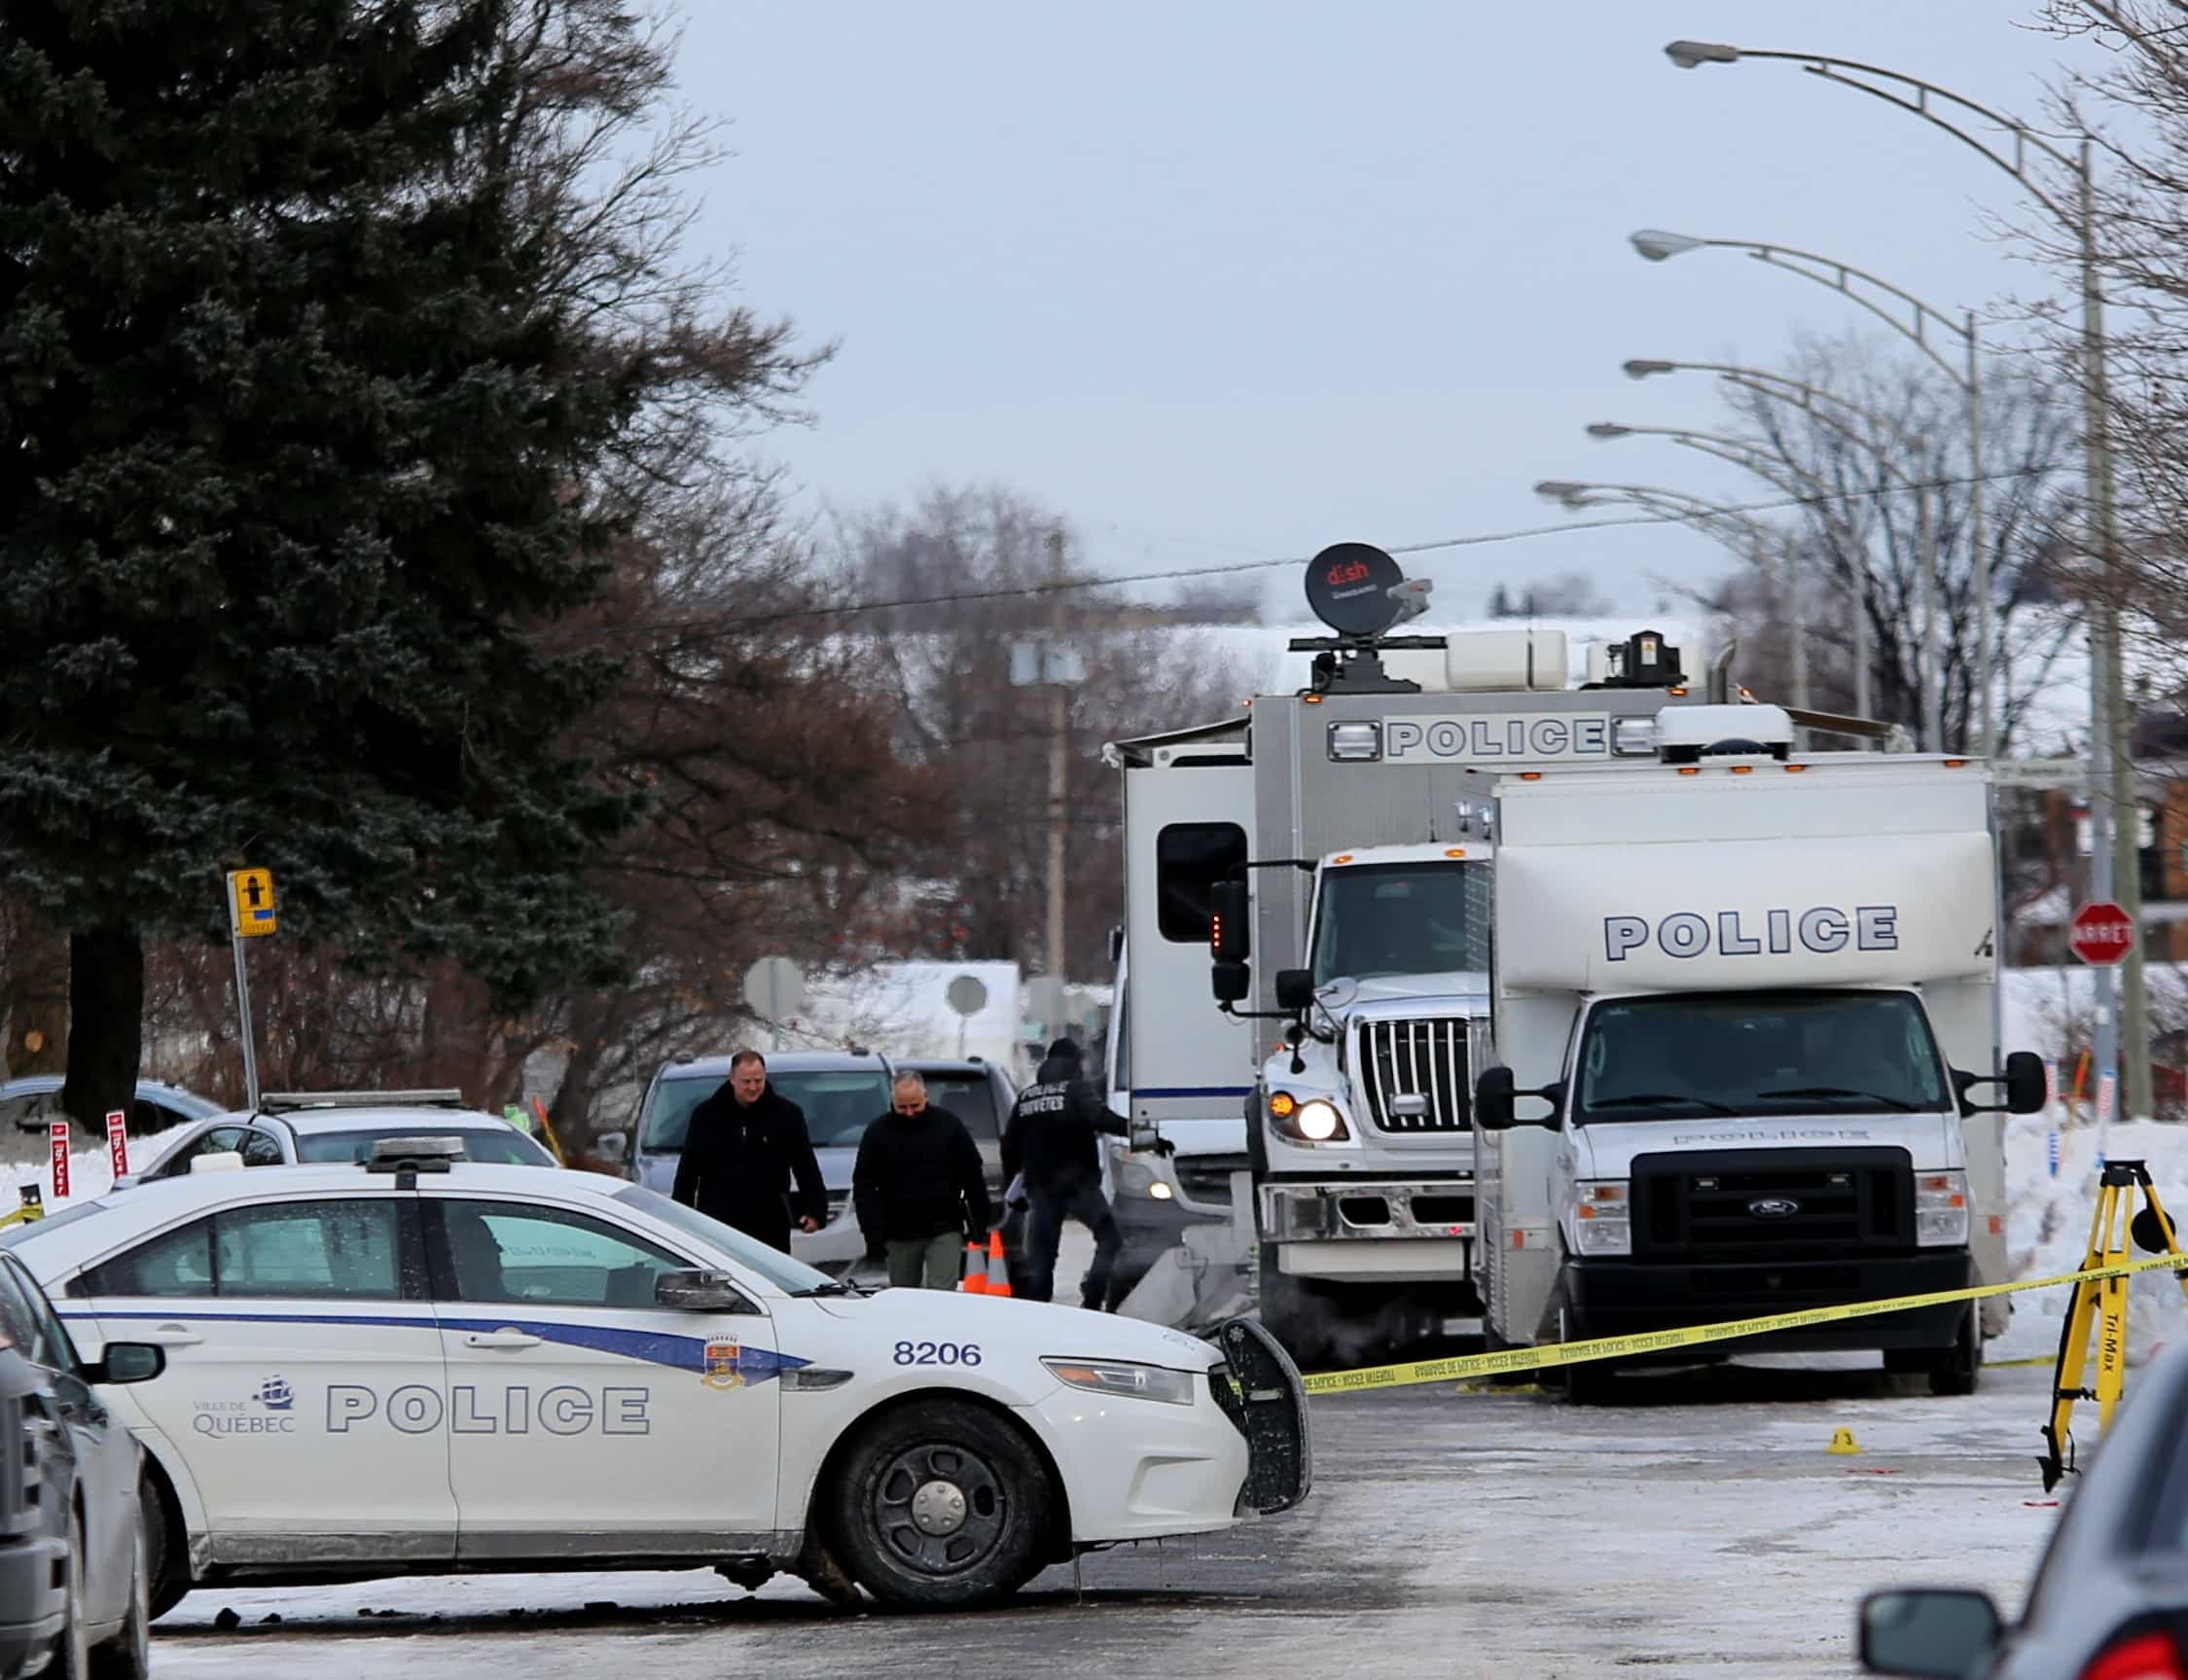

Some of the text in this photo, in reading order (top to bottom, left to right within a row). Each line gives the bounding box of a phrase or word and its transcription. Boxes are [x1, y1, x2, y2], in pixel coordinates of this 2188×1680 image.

[1327, 560, 1370, 586] dish
[1387, 719, 1604, 757] POLICE
[1604, 906, 1898, 961] POLICE
[1673, 1129, 1870, 1145] POLICE
[893, 1341, 982, 1366] 8206
[2103, 1314, 2119, 1373] Tri-Max
[194, 1400, 246, 1411] VILLE DE
[327, 1384, 650, 1435] POLICE
[193, 1412, 295, 1439] QUÉBEC
